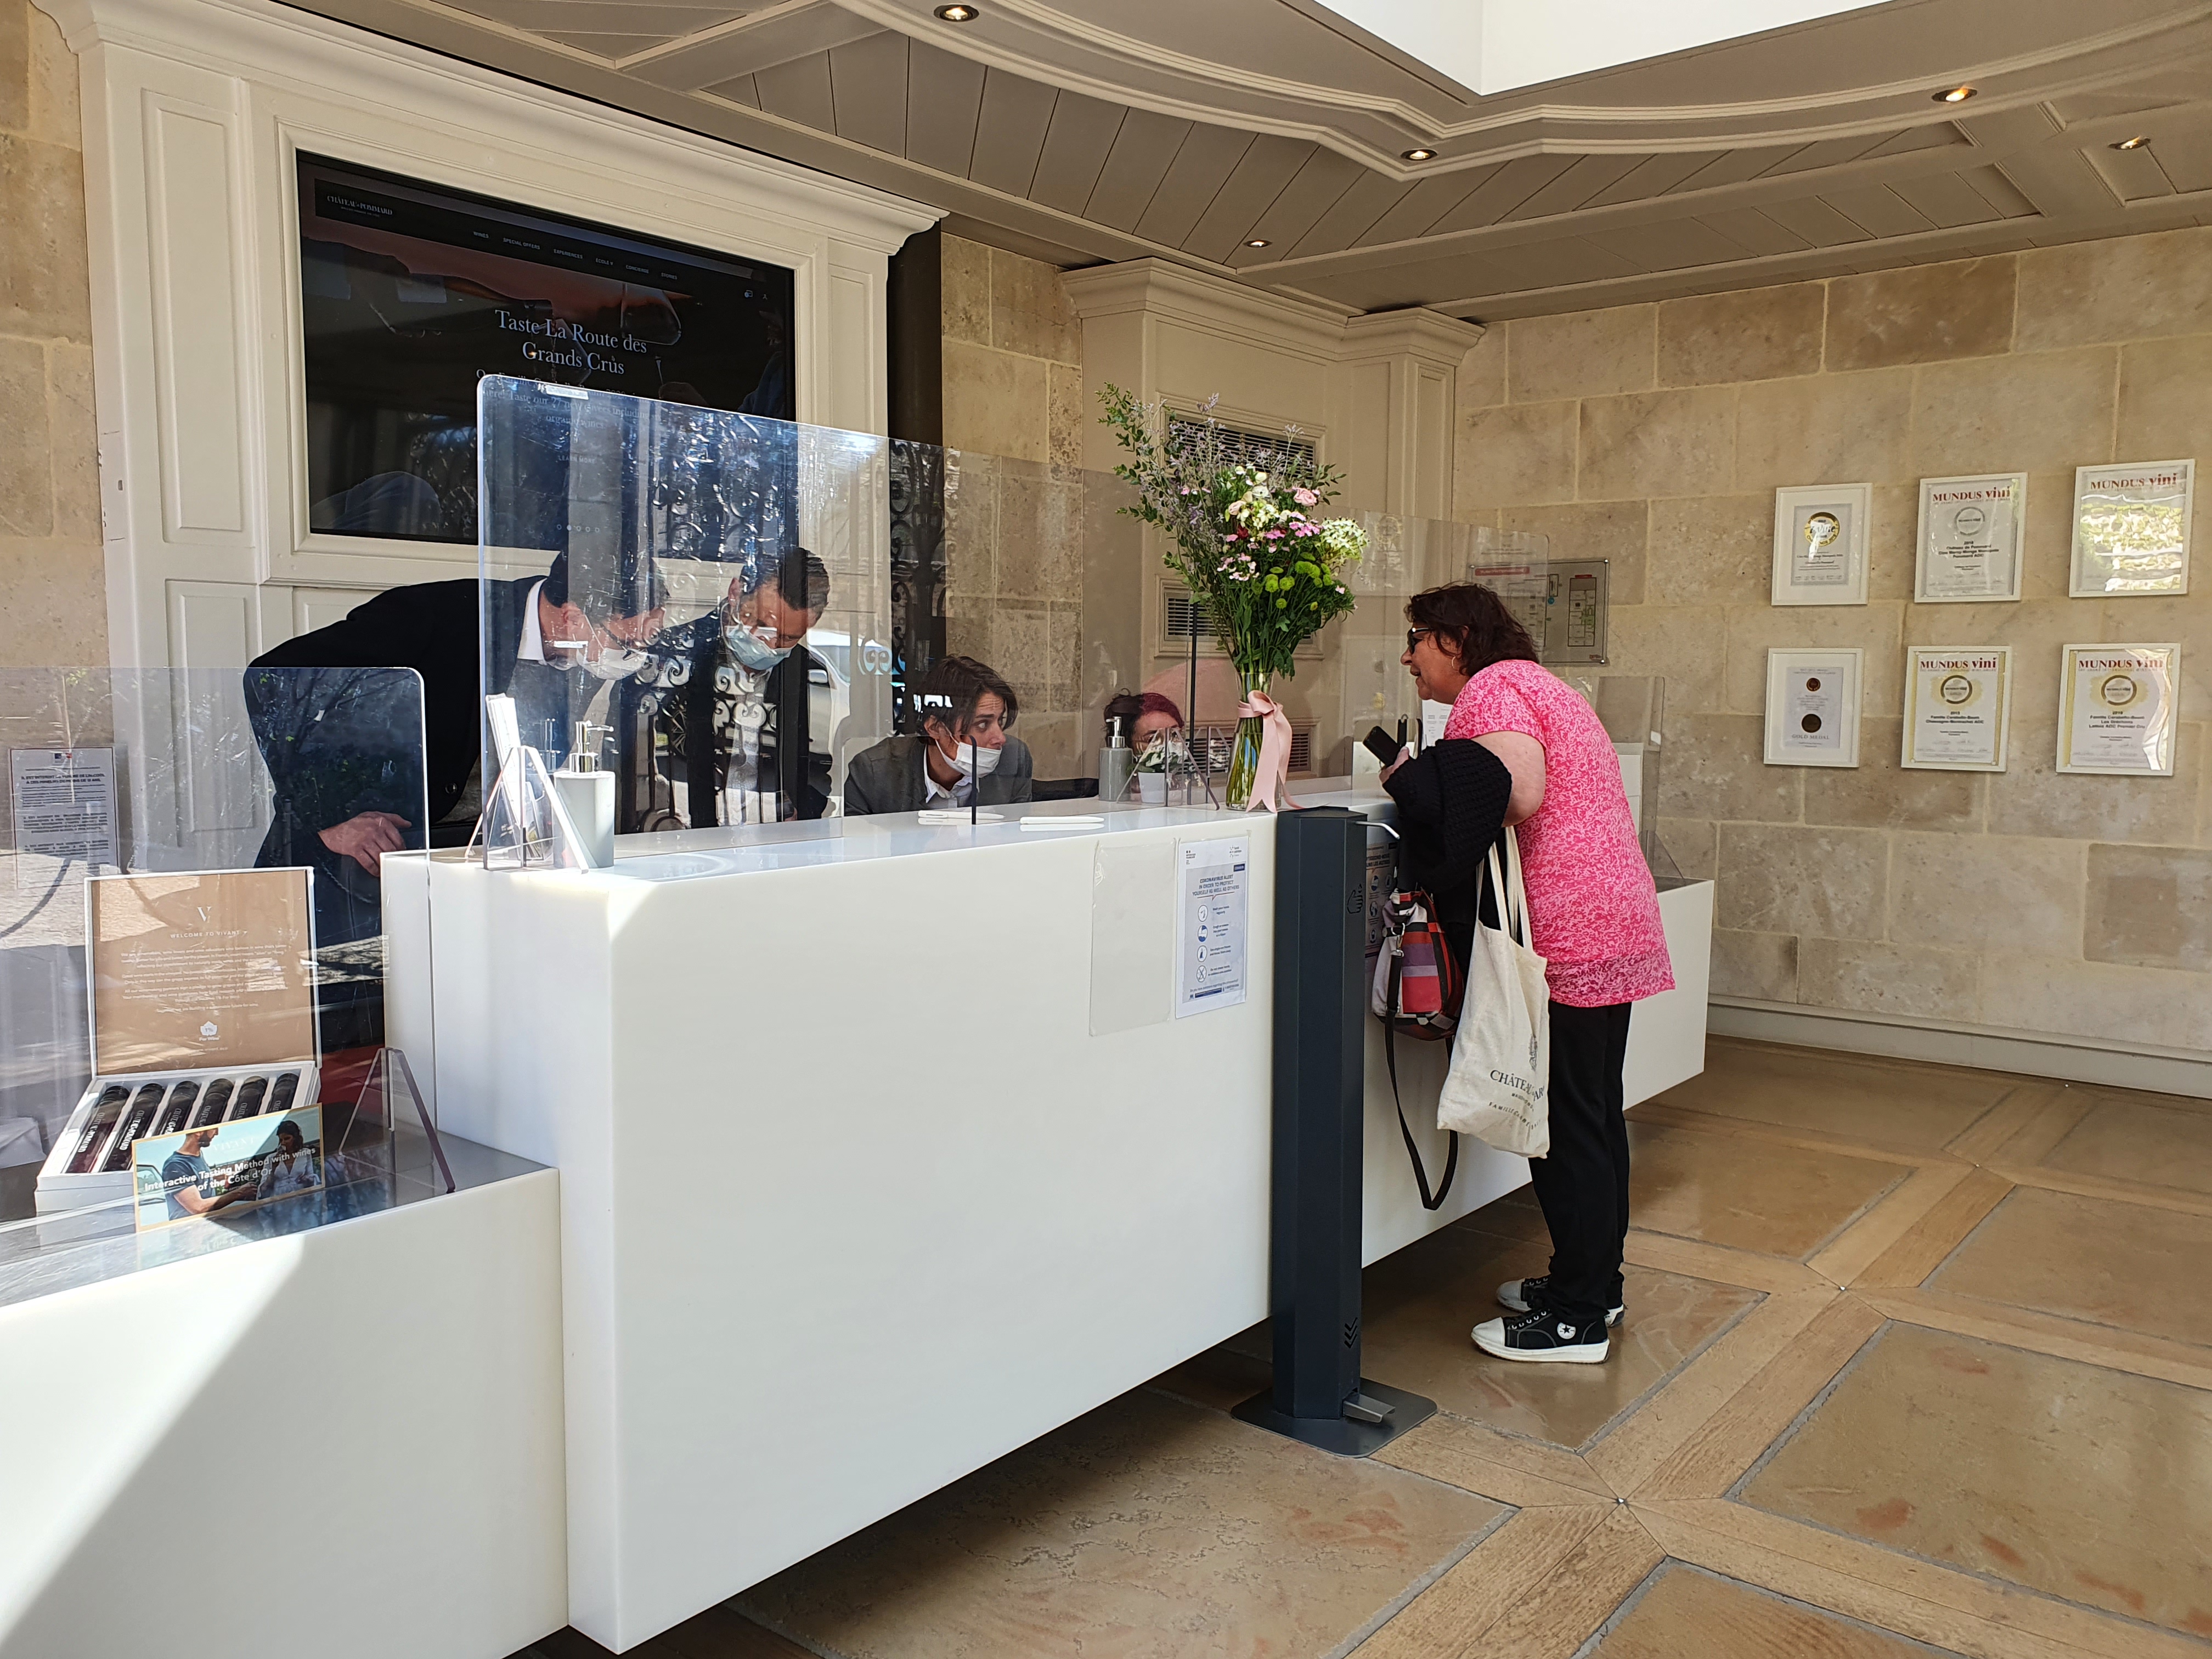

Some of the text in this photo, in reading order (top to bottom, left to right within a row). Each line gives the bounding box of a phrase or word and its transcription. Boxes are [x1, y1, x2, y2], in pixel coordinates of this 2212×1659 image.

[503, 238, 540, 250] SPECIAL OFFERS
[554, 249, 583, 259] EXPERIENCES
[625, 264, 650, 274] CONCIERGE
[495, 309, 647, 353] Taste La Route des
[522, 342, 582, 368] Grands
[2090, 472, 2178, 489] MUNDUS vini
[1932, 491, 1982, 502] MUNDUS
[1985, 485, 2011, 498] vini
[1920, 657, 1997, 669] MUNDUS vini
[2079, 659, 2132, 669] MUNDUS
[144, 1147, 316, 1192] Interactive Tasting Method with wines
[198, 1168, 273, 1191] of the Côte d'Or
